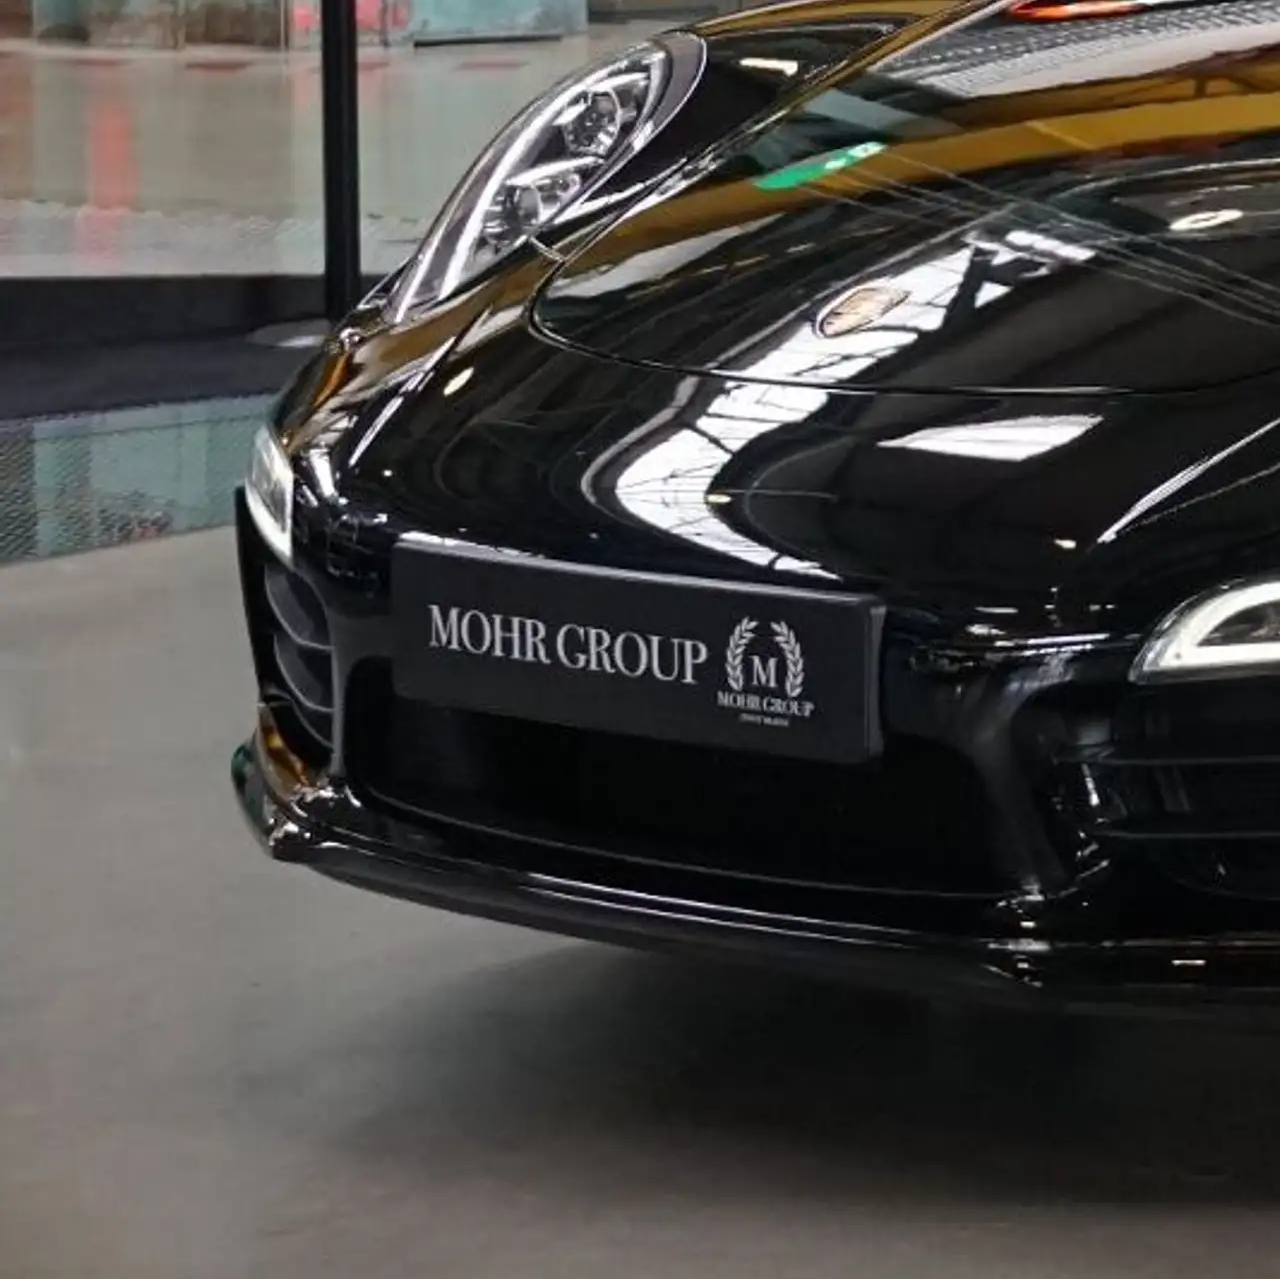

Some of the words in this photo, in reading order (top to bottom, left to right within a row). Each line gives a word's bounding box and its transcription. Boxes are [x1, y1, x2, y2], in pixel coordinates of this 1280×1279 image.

[428, 604, 551, 664] MOHR
[556, 623, 708, 685] GROUP
[749, 654, 779, 688] M
